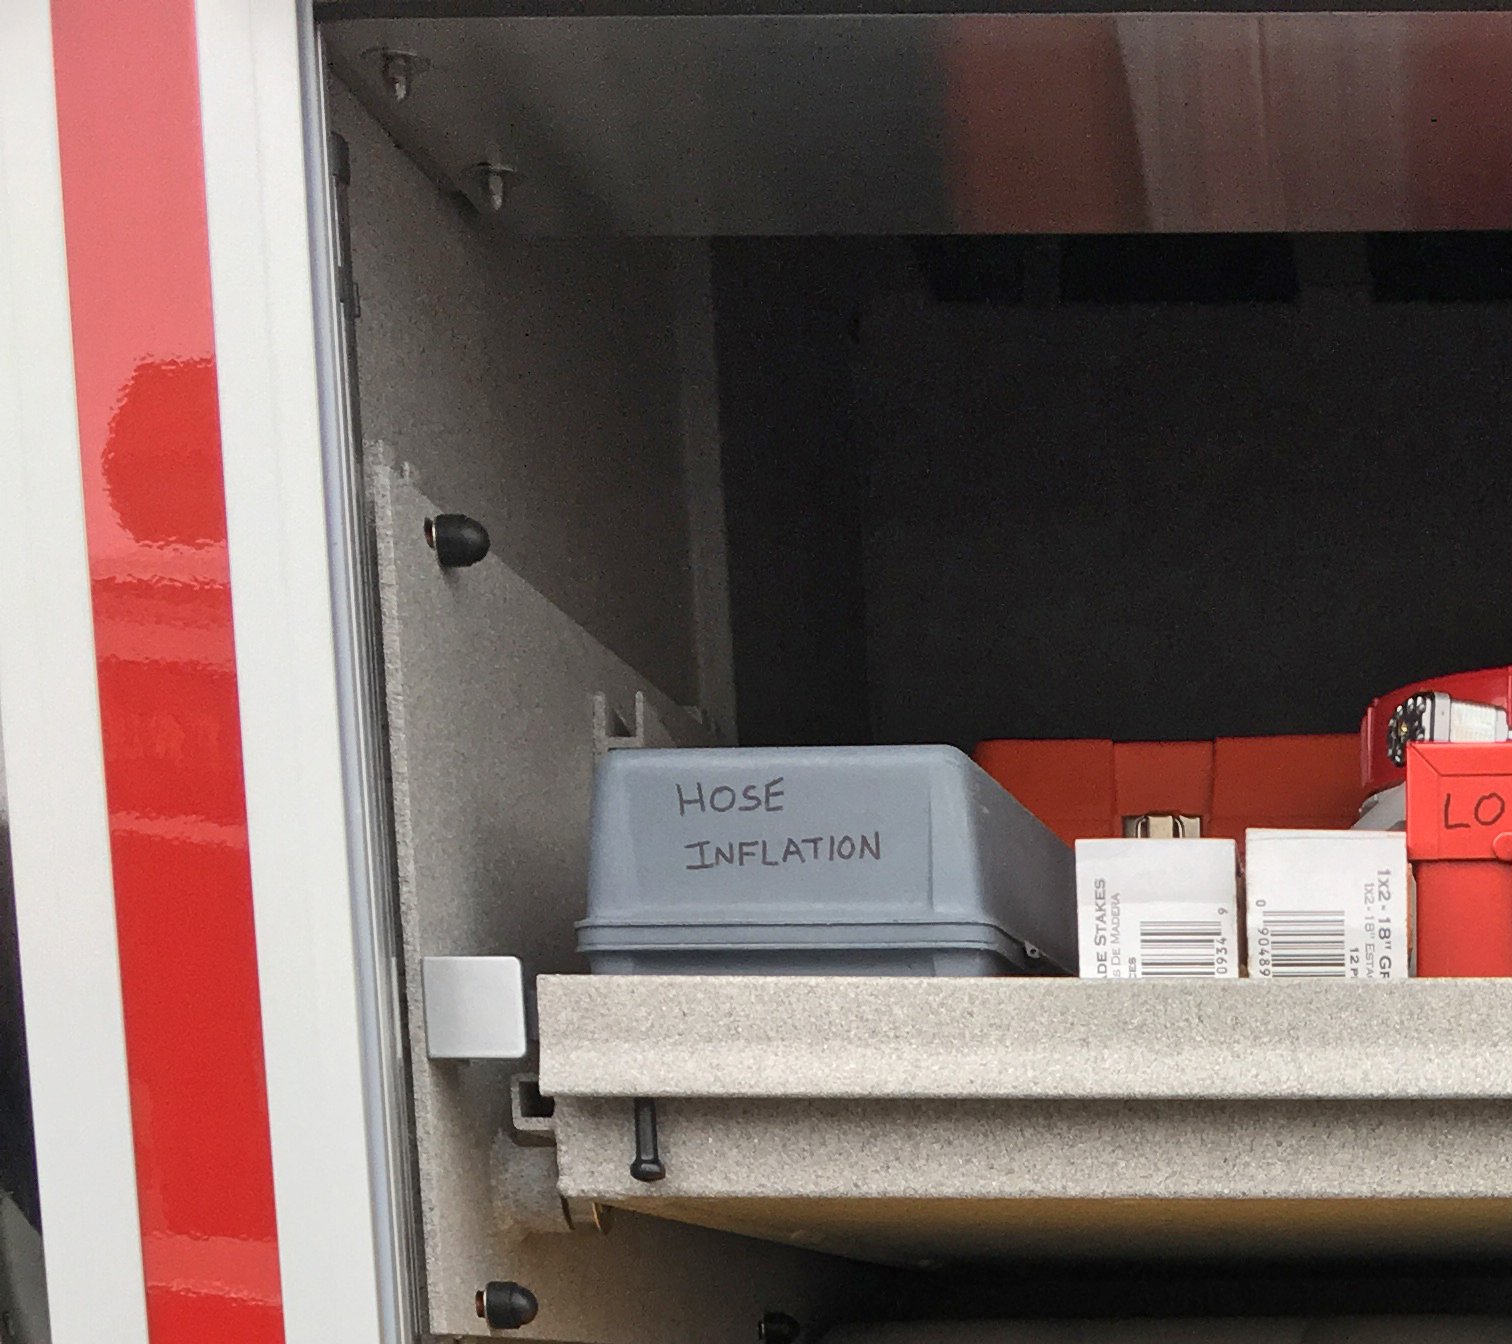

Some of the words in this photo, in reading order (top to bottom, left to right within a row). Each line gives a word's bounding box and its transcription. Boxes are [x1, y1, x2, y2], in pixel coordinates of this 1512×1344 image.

[676, 777, 784, 816] HOSE
[1443, 792, 1505, 829] LO
[684, 831, 881, 870] INFLATION
[1094, 878, 1107, 945] STAKES
[1095, 949, 1107, 978] DE
[1365, 943, 1375, 978] ESTA
